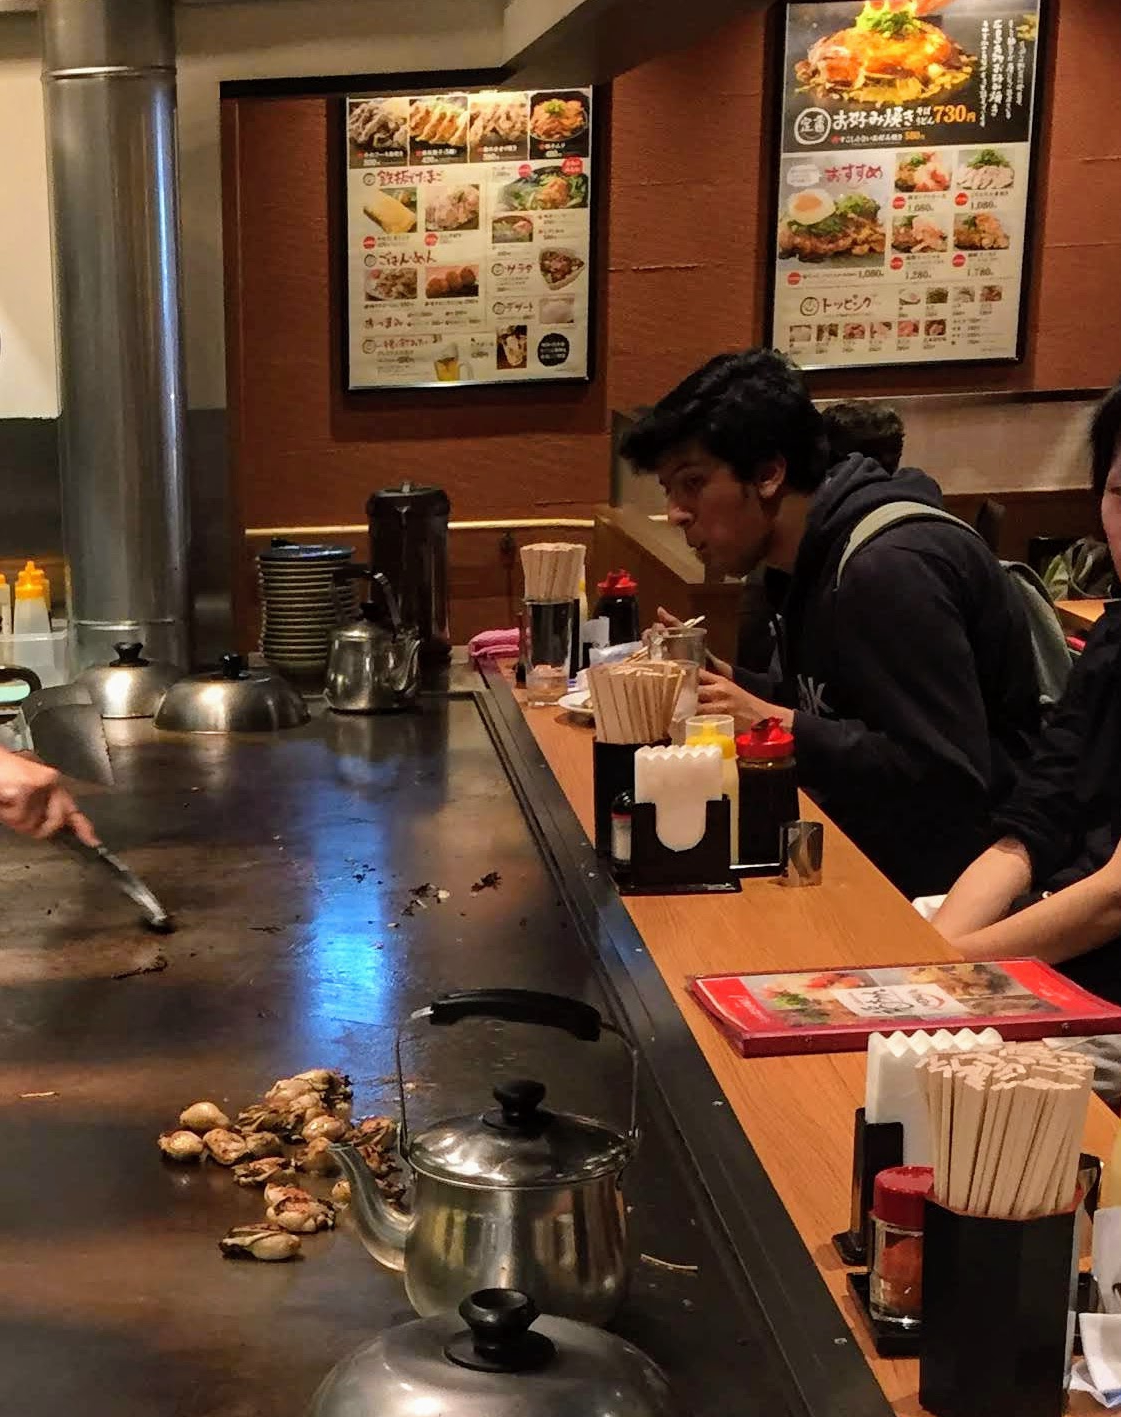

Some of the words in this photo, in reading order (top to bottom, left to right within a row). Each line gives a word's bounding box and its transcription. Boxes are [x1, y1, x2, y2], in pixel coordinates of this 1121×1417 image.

[832, 105, 915, 131] お好み焼き
[933, 104, 976, 123] 730円
[800, 114, 826, 133] 定番
[824, 164, 884, 183] おすすめ
